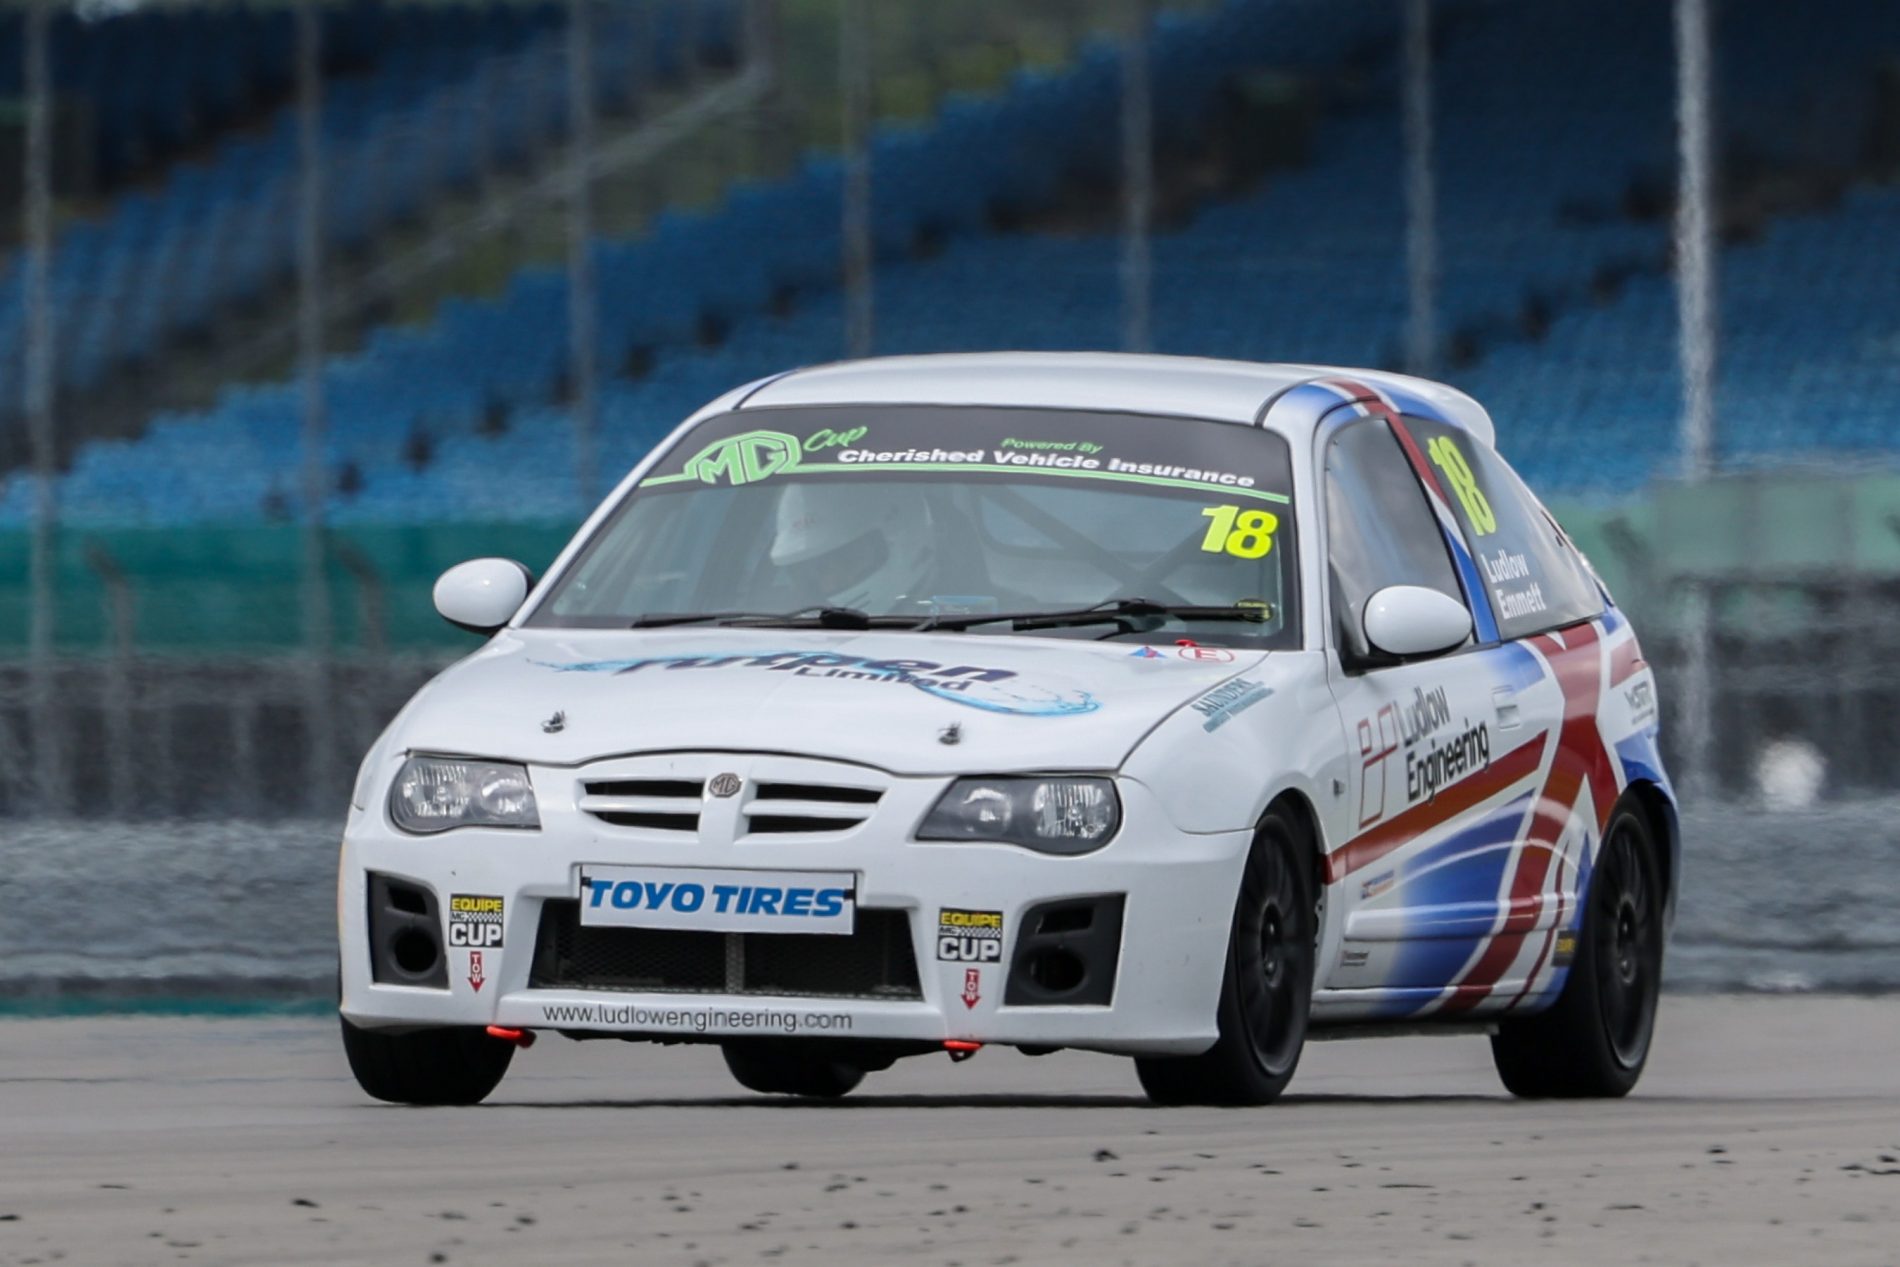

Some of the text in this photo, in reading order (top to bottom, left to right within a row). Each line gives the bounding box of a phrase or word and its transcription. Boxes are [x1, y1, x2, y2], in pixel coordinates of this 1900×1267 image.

[694, 426, 868, 486] MG Cup
[1000, 438, 1103, 454] Powered By
[838, 448, 1255, 487] Cherished Vehicle Insurance
[1427, 436, 1497, 536] 18
[1201, 505, 1278, 559] 18
[1480, 549, 1530, 584] Ludlow
[1495, 582, 1547, 619] Emmett
[793, 667, 972, 691] Limited
[1393, 685, 1451, 748] Ludlow
[1405, 717, 1490, 806] Engineering
[709, 773, 741, 798] MG
[451, 897, 503, 912] EQUIPE
[590, 880, 845, 917] TOYO TIRES
[450, 922, 502, 946] CUP
[941, 912, 1002, 928] EQUIPE
[939, 937, 1001, 961] CUP
[471, 954, 481, 983] TOW
[966, 971, 977, 1001] TOW
[543, 1004, 853, 1031] www.ludlowengineering.com
